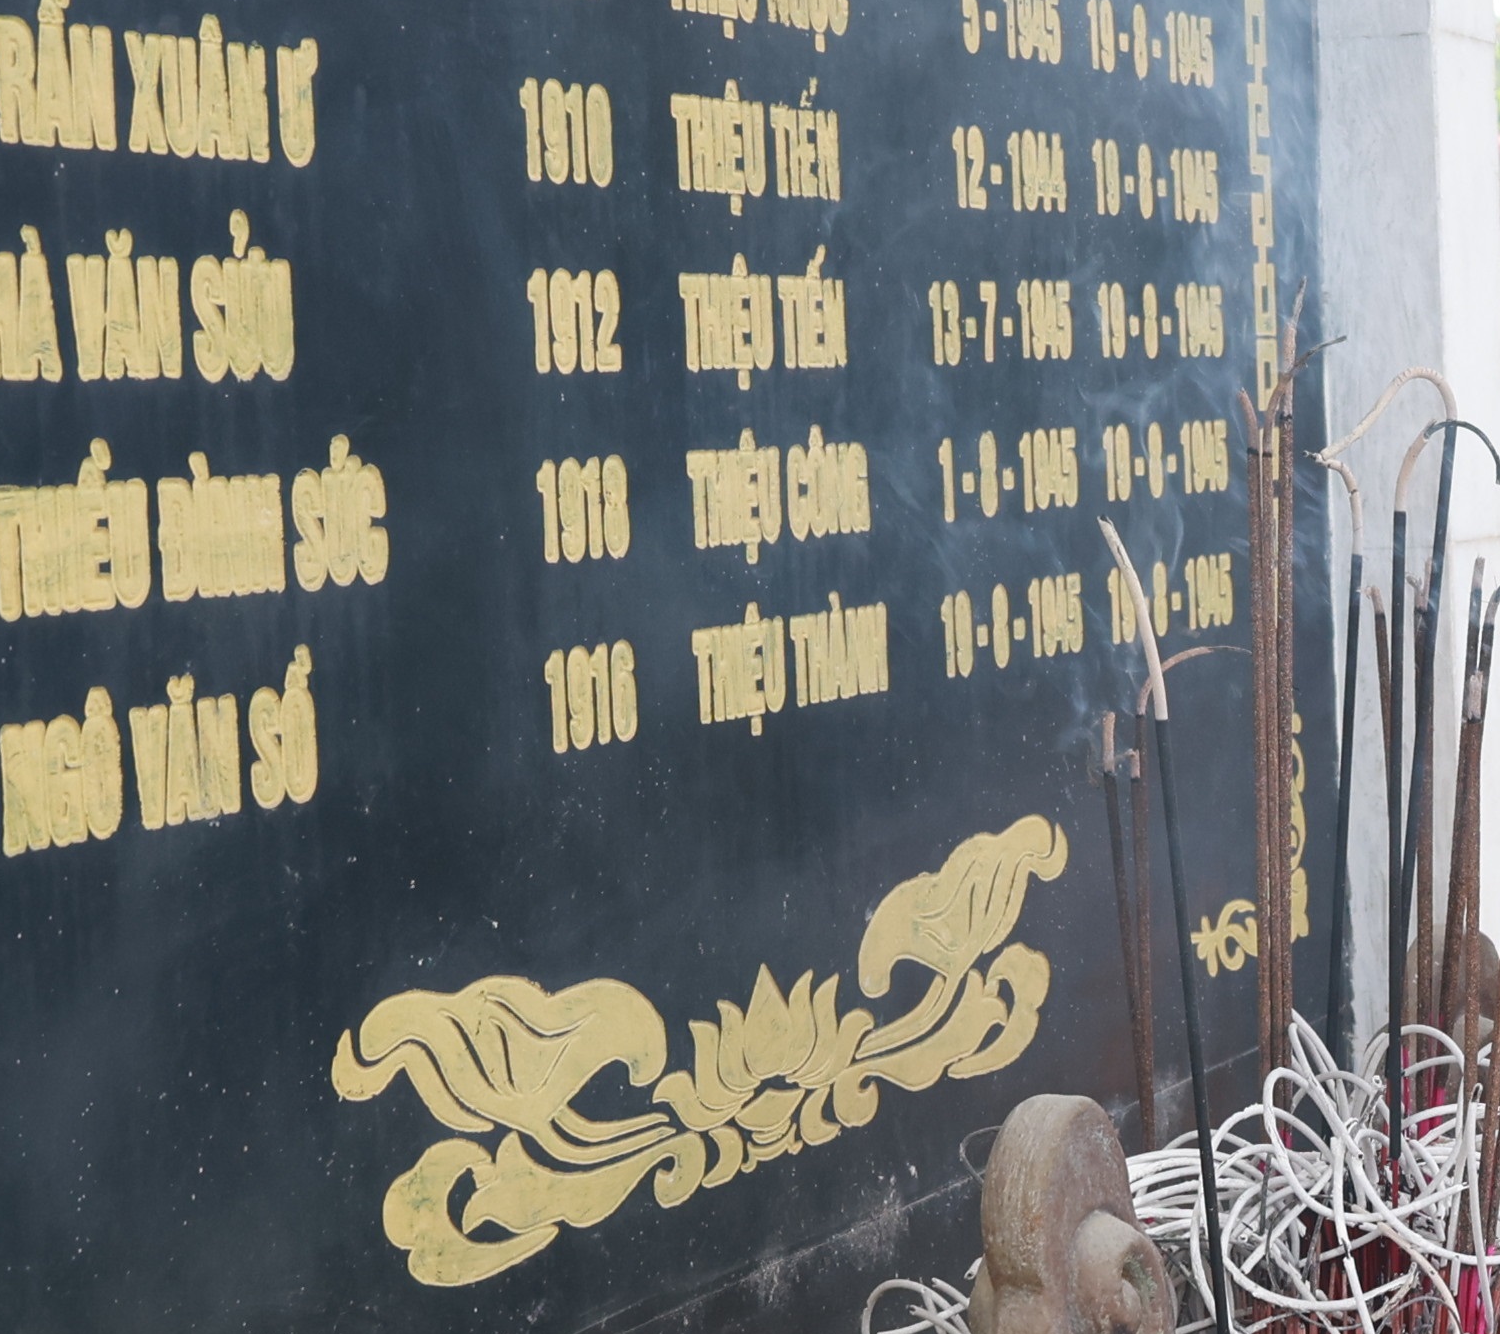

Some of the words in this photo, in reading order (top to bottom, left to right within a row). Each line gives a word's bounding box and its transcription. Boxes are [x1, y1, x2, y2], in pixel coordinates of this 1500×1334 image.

[124, 13, 270, 163] XUÂN
[276, 38, 318, 167] Ư
[519, 76, 613, 188] 1910
[670, 78, 766, 216] THIỆU
[770, 76, 841, 201] TIẾN
[66, 227, 182, 381] VĂN
[191, 208, 295, 382] SỬU
[527, 267, 622, 375] 1912
[679, 252, 775, 390] THIỆU
[777, 244, 847, 369] TIẾN
[536, 454, 630, 563] 1918
[686, 427, 781, 565] THIỆU
[787, 423, 871, 542] CÔNG
[0, 686, 123, 857] NGÔ
[129, 672, 240, 830] VĂN
[544, 639, 638, 754] 1916
[692, 601, 786, 736] THIỆU
